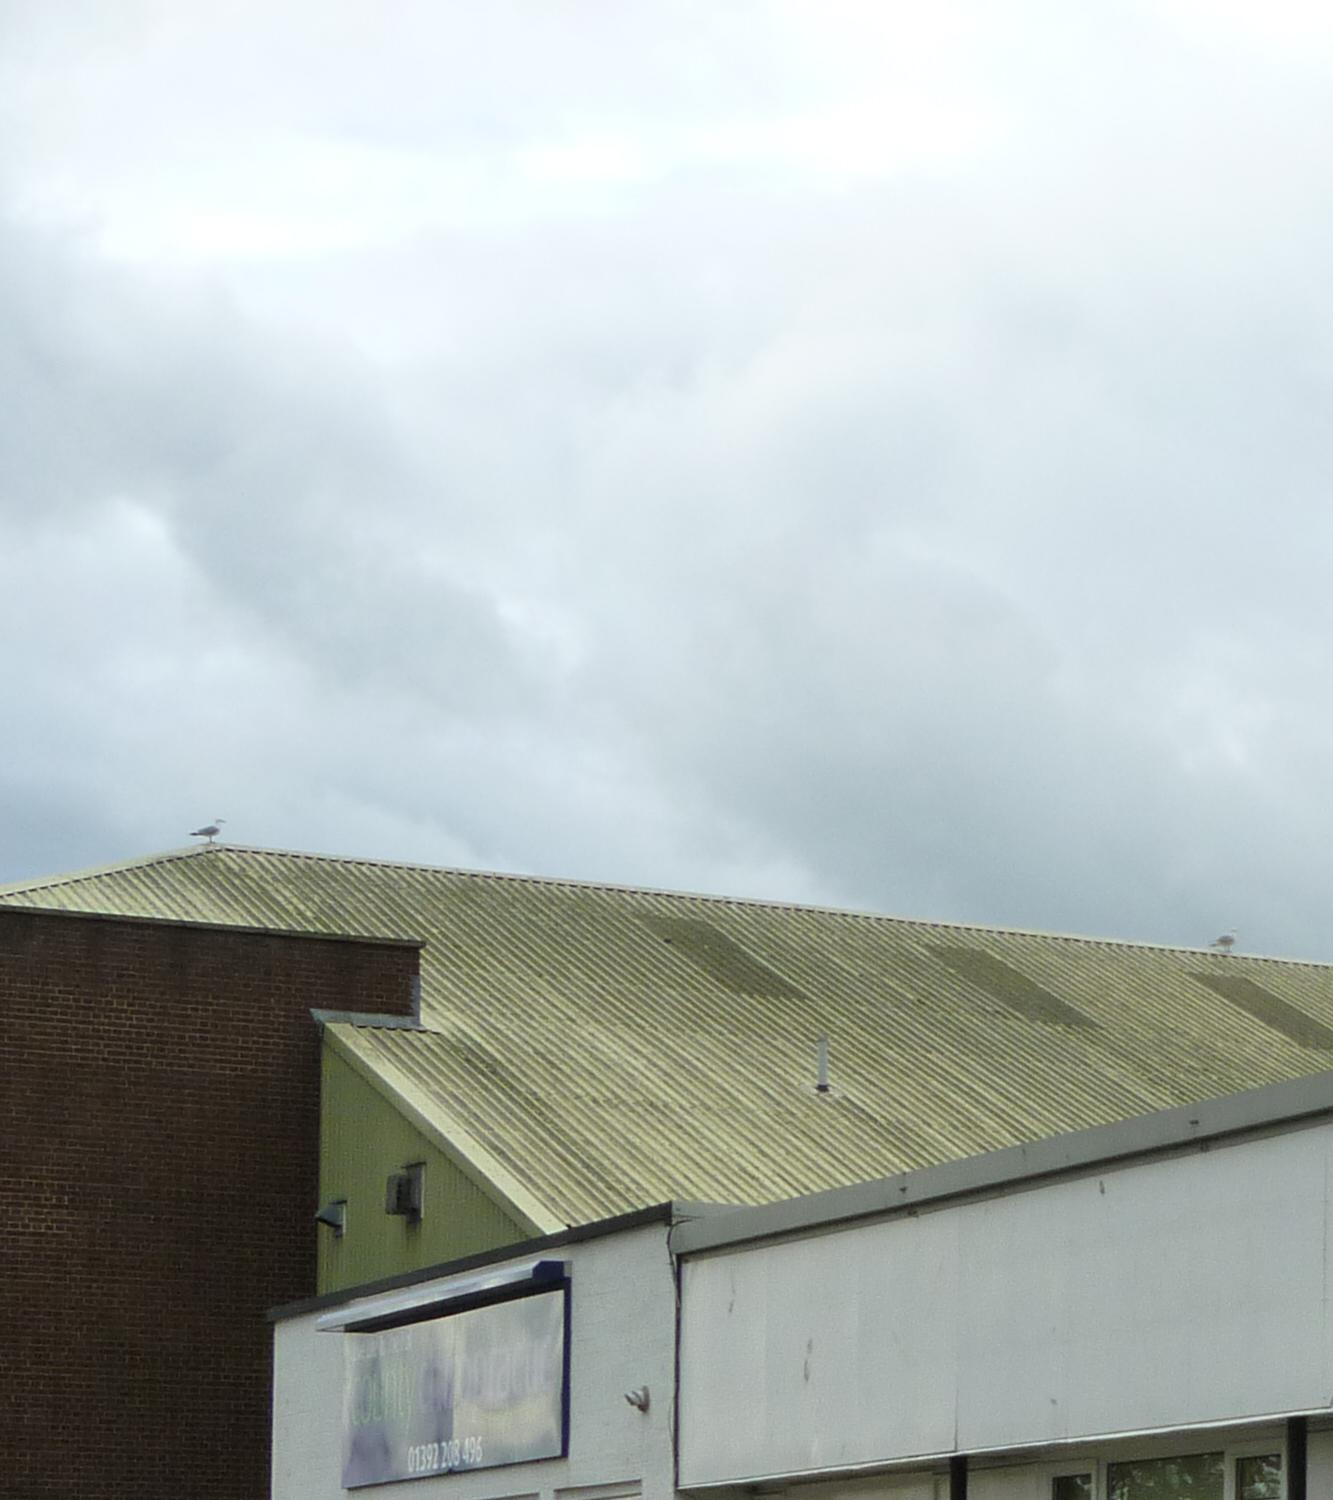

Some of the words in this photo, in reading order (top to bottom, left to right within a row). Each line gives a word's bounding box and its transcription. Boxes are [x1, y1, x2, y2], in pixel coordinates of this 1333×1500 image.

[408, 1442, 438, 1472] 01392
[441, 1439, 460, 1468] 208
[463, 1435, 483, 1464] 496
